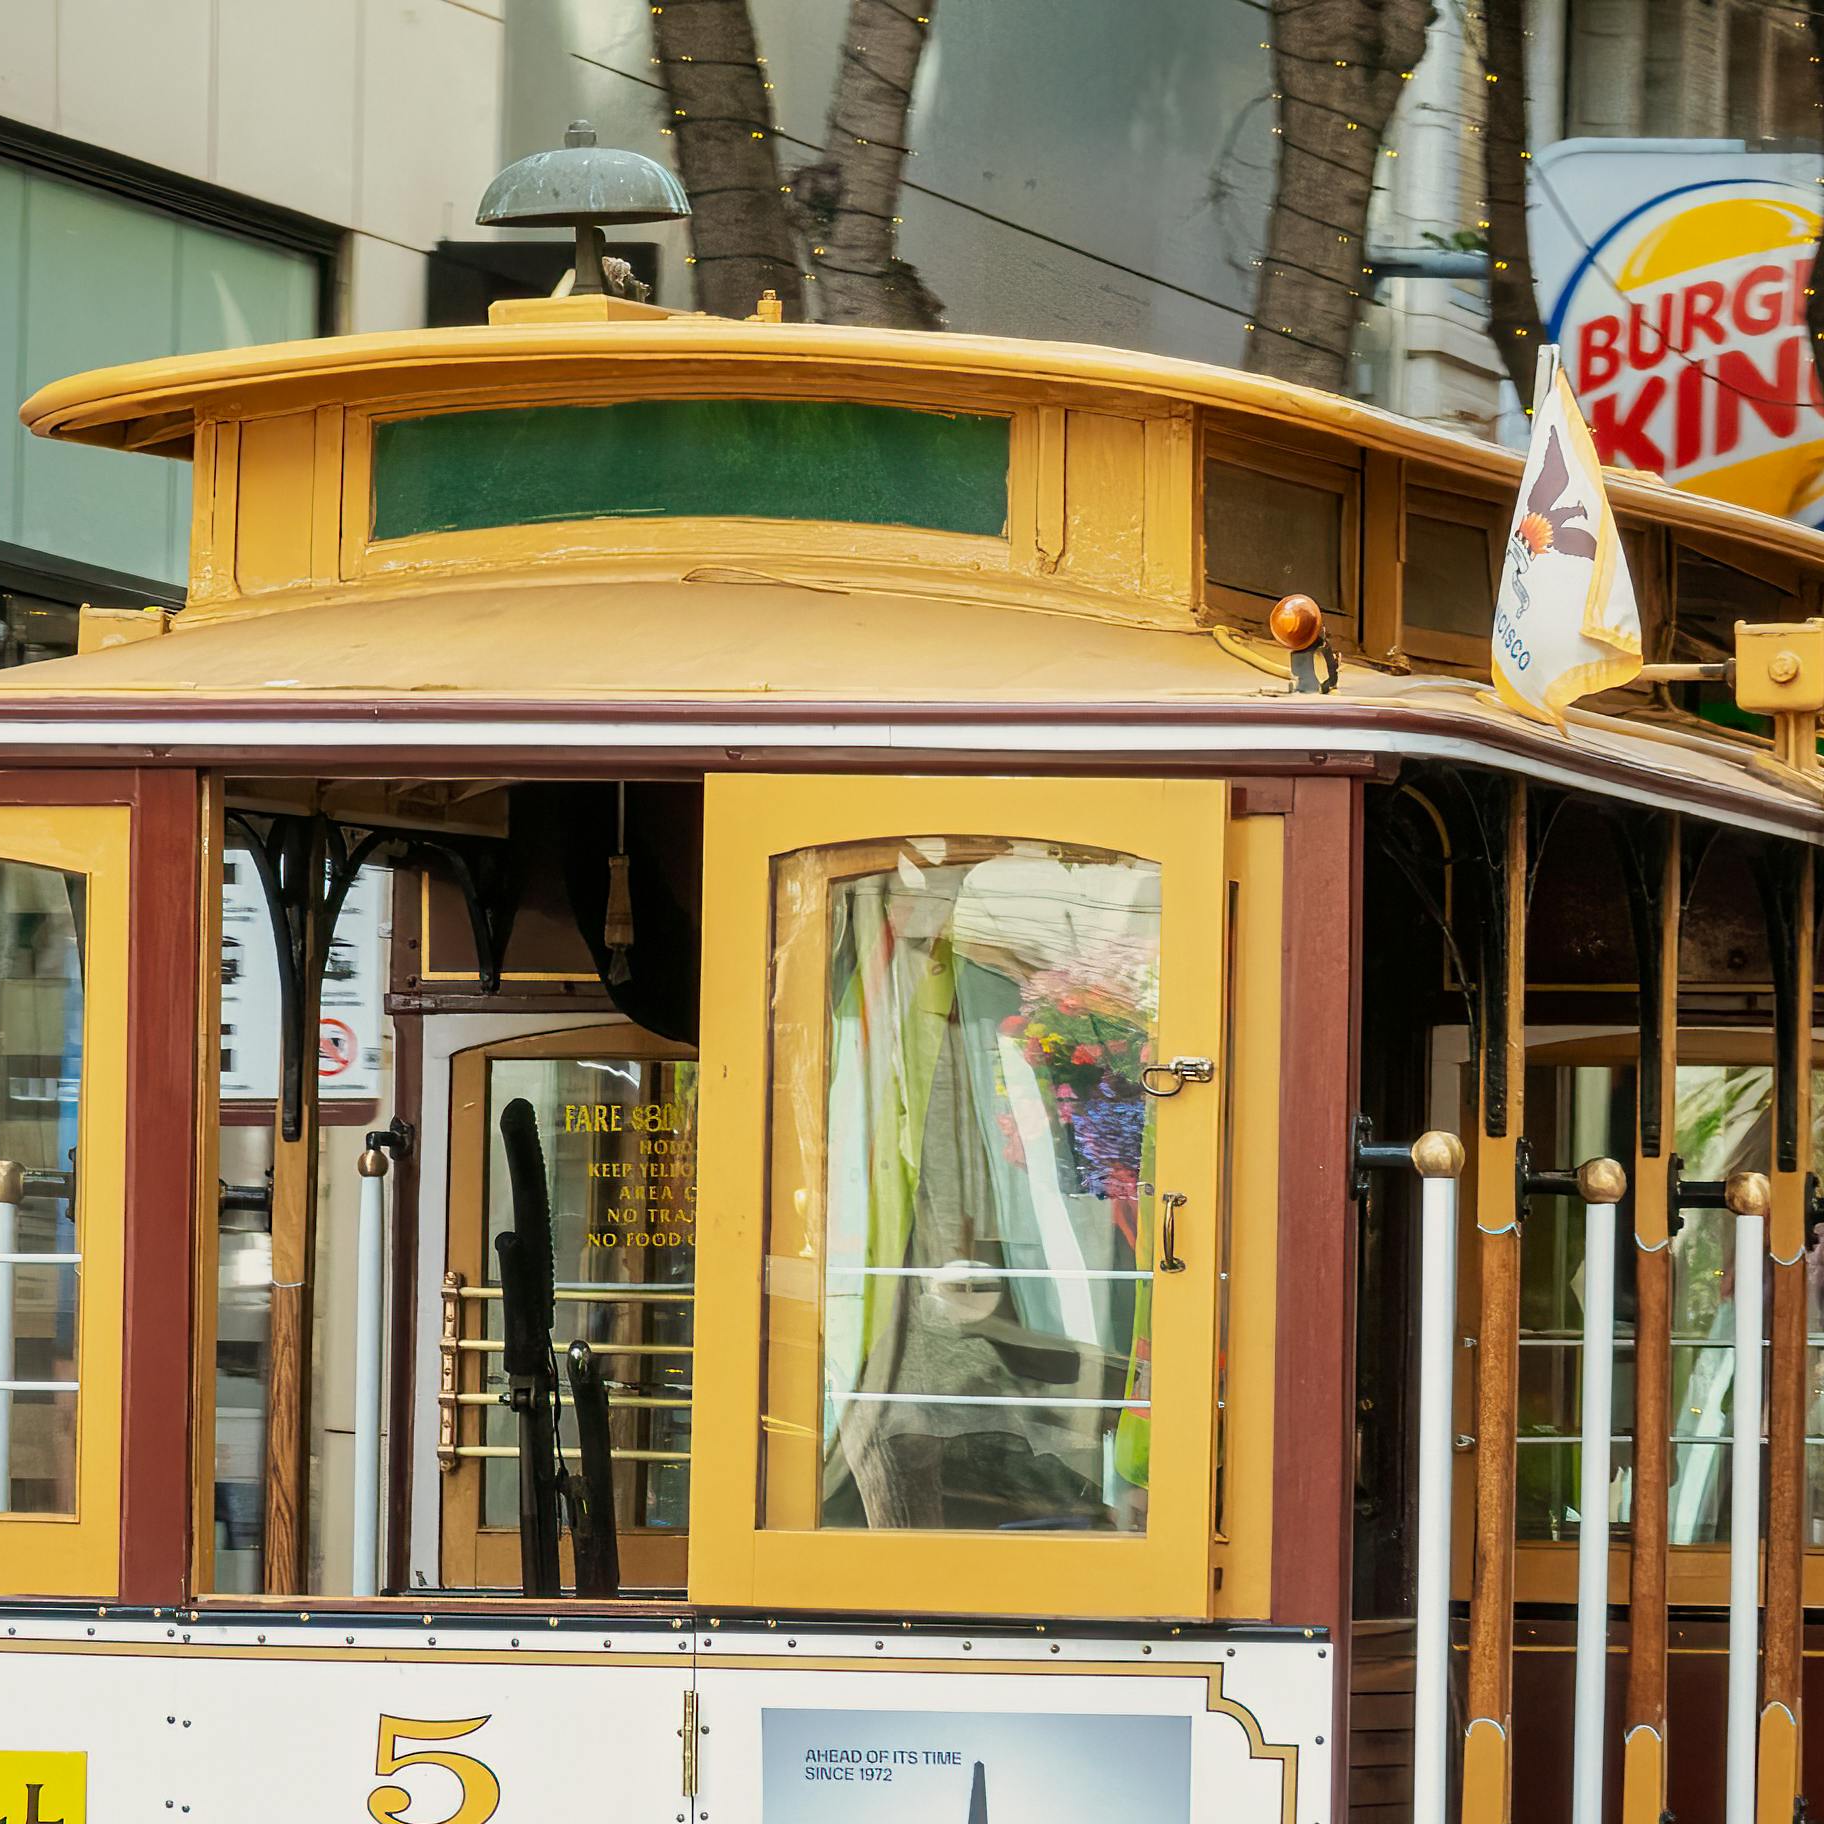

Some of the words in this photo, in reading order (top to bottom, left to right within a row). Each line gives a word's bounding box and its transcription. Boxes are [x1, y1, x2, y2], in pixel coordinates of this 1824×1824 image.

[564, 1103, 623, 1133] FARE
[588, 1163, 632, 1178] KEEP
[639, 1163, 696, 1178] YELLO
[619, 1185, 674, 1201] AREA
[607, 1207, 638, 1223] NO
[587, 1232, 618, 1247] NO
[626, 1232, 682, 1247] FOOD
[805, 1749, 862, 1763] AHEAD
[866, 1750, 889, 1764] OF
[893, 1750, 918, 1765] ITS
[922, 1751, 962, 1766] TIME
[805, 1766, 855, 1781] SINCE
[860, 1767, 893, 1782] 1972
